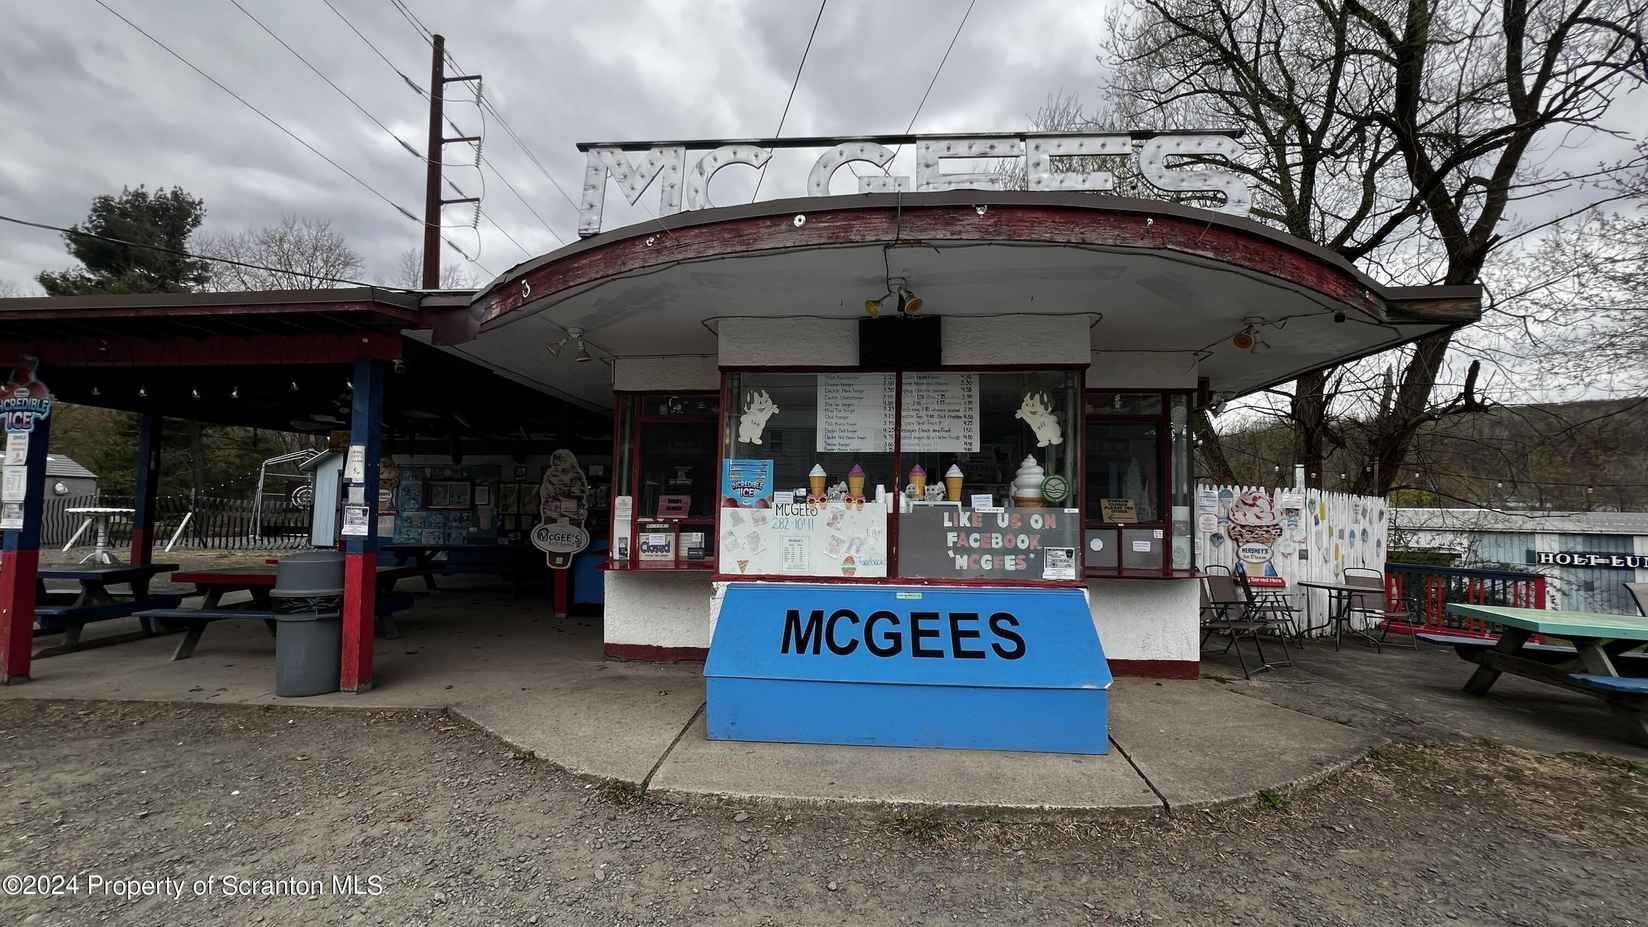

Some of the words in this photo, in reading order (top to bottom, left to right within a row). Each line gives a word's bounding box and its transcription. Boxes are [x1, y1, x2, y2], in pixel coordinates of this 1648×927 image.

[8, 411, 32, 429] ICE
[739, 487, 755, 497] ICE
[943, 511, 983, 528] LIKE
[996, 512, 1022, 529] US
[1029, 513, 1057, 530] ON
[946, 531, 1041, 550] FACEBOOK
[781, 608, 1026, 660] MCGEES
